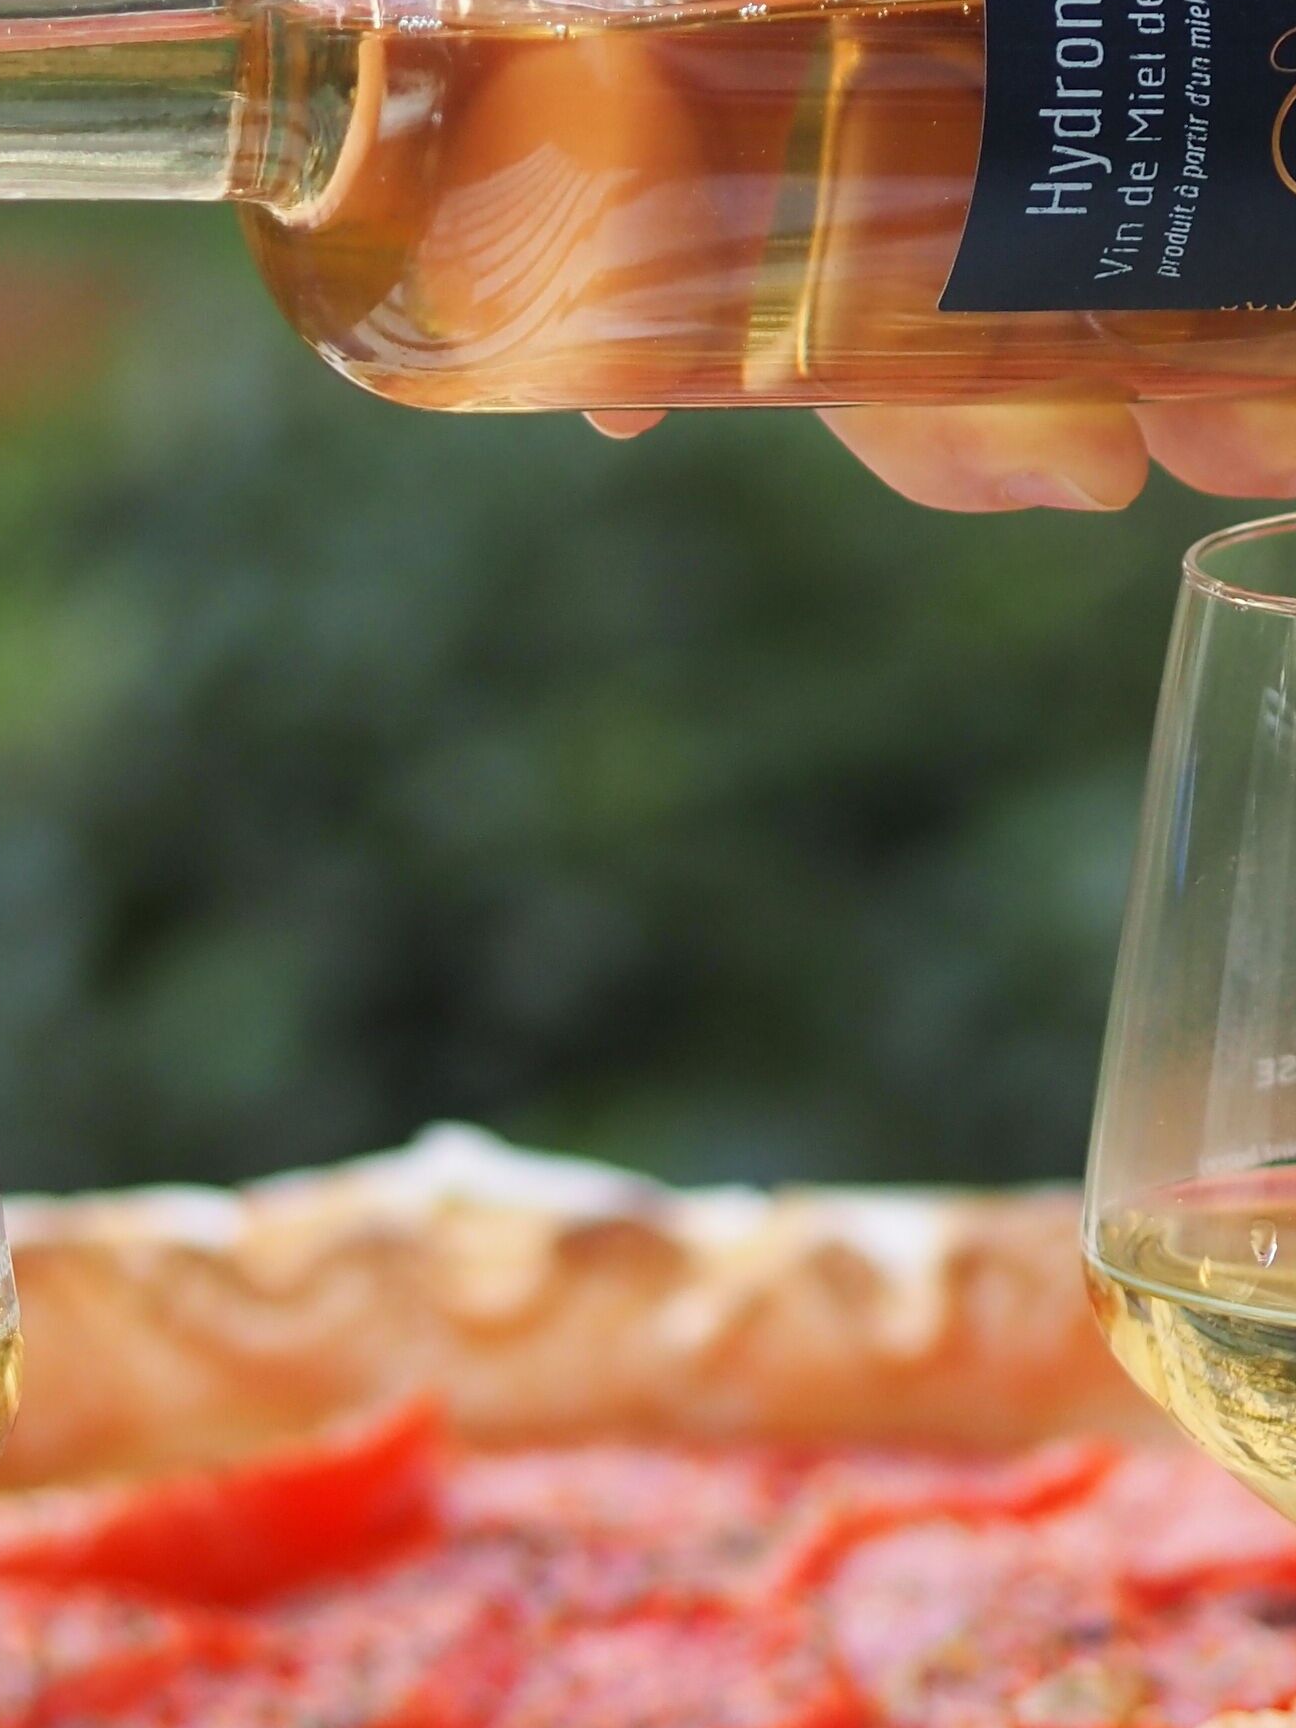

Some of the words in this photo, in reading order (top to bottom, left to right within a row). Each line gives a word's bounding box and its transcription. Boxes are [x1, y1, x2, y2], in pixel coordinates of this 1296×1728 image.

[1125, 53, 1166, 142] Miel
[1180, 58, 1210, 106] d'un
[1177, 113, 1211, 181] partir
[1117, 161, 1158, 206] de
[1172, 184, 1200, 199] à
[1094, 222, 1144, 280] Vin
[1154, 205, 1198, 277] produit
